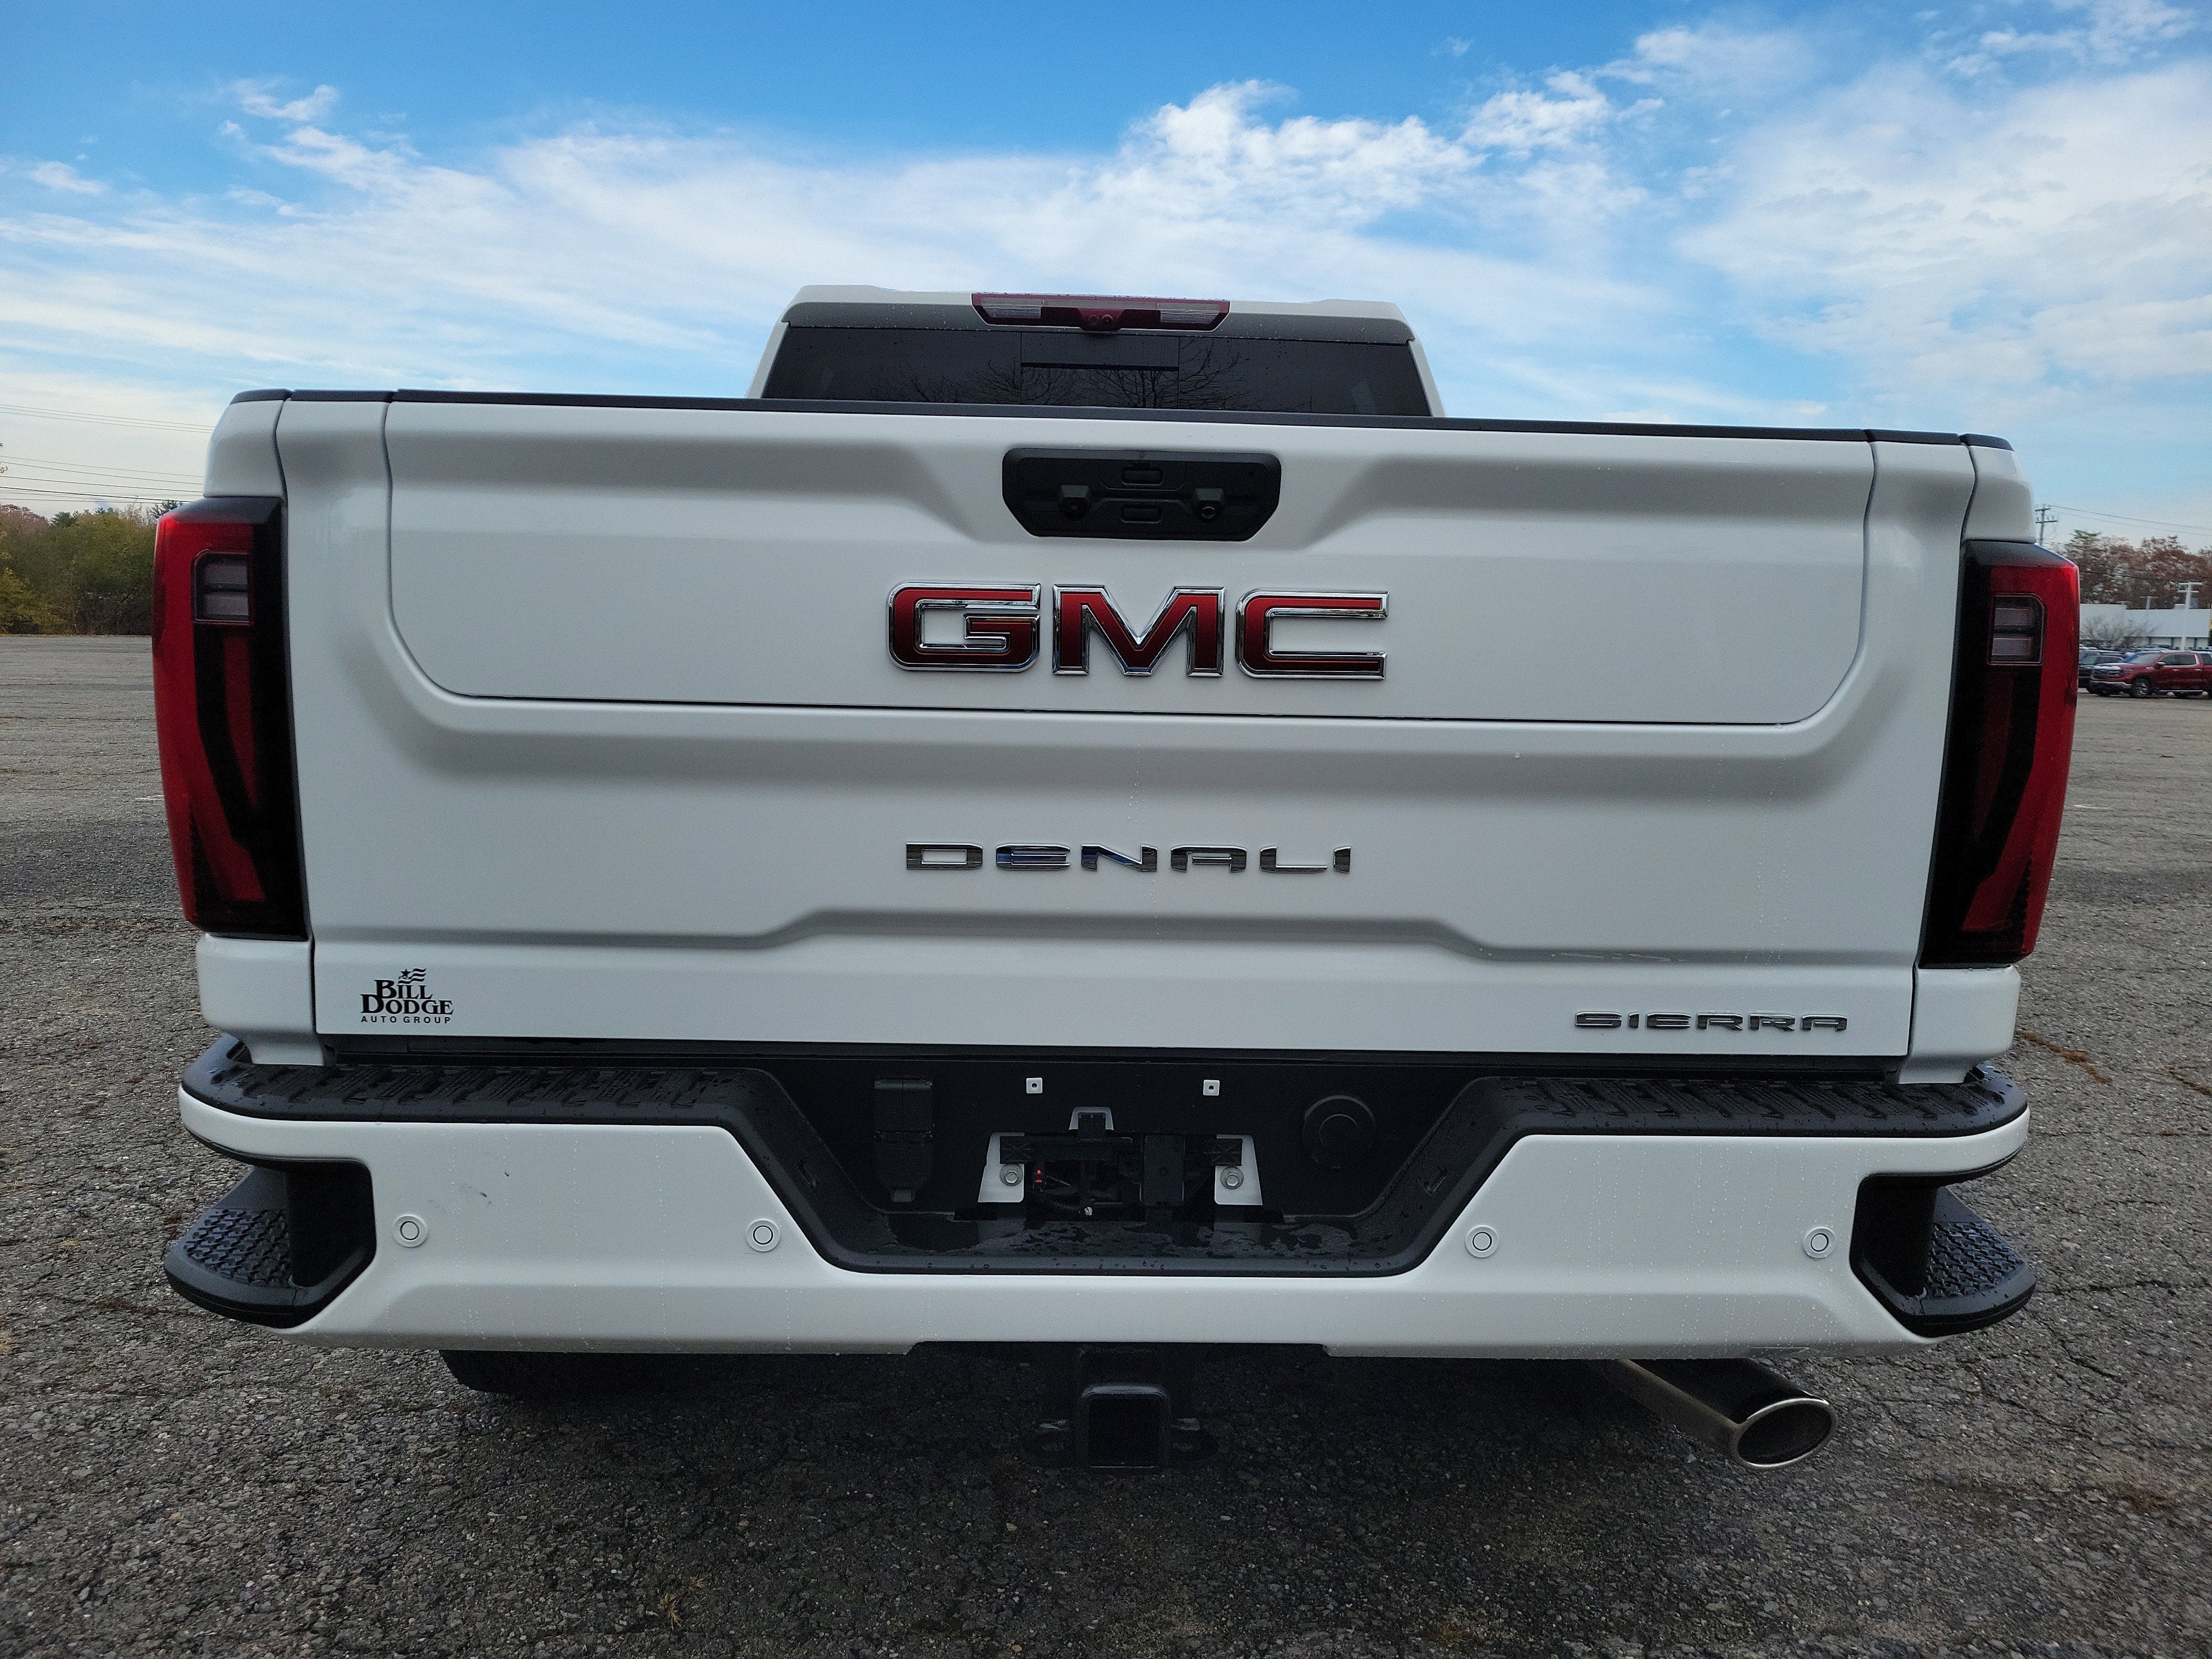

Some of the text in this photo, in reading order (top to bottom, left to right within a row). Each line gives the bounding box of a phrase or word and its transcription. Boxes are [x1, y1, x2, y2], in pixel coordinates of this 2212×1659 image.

[888, 582, 1389, 680] GMC
[906, 842, 1351, 873] DENALI
[374, 979, 433, 1000] BILL
[360, 994, 454, 1015] DODGE
[1575, 1012, 1848, 1031] SIERRA
